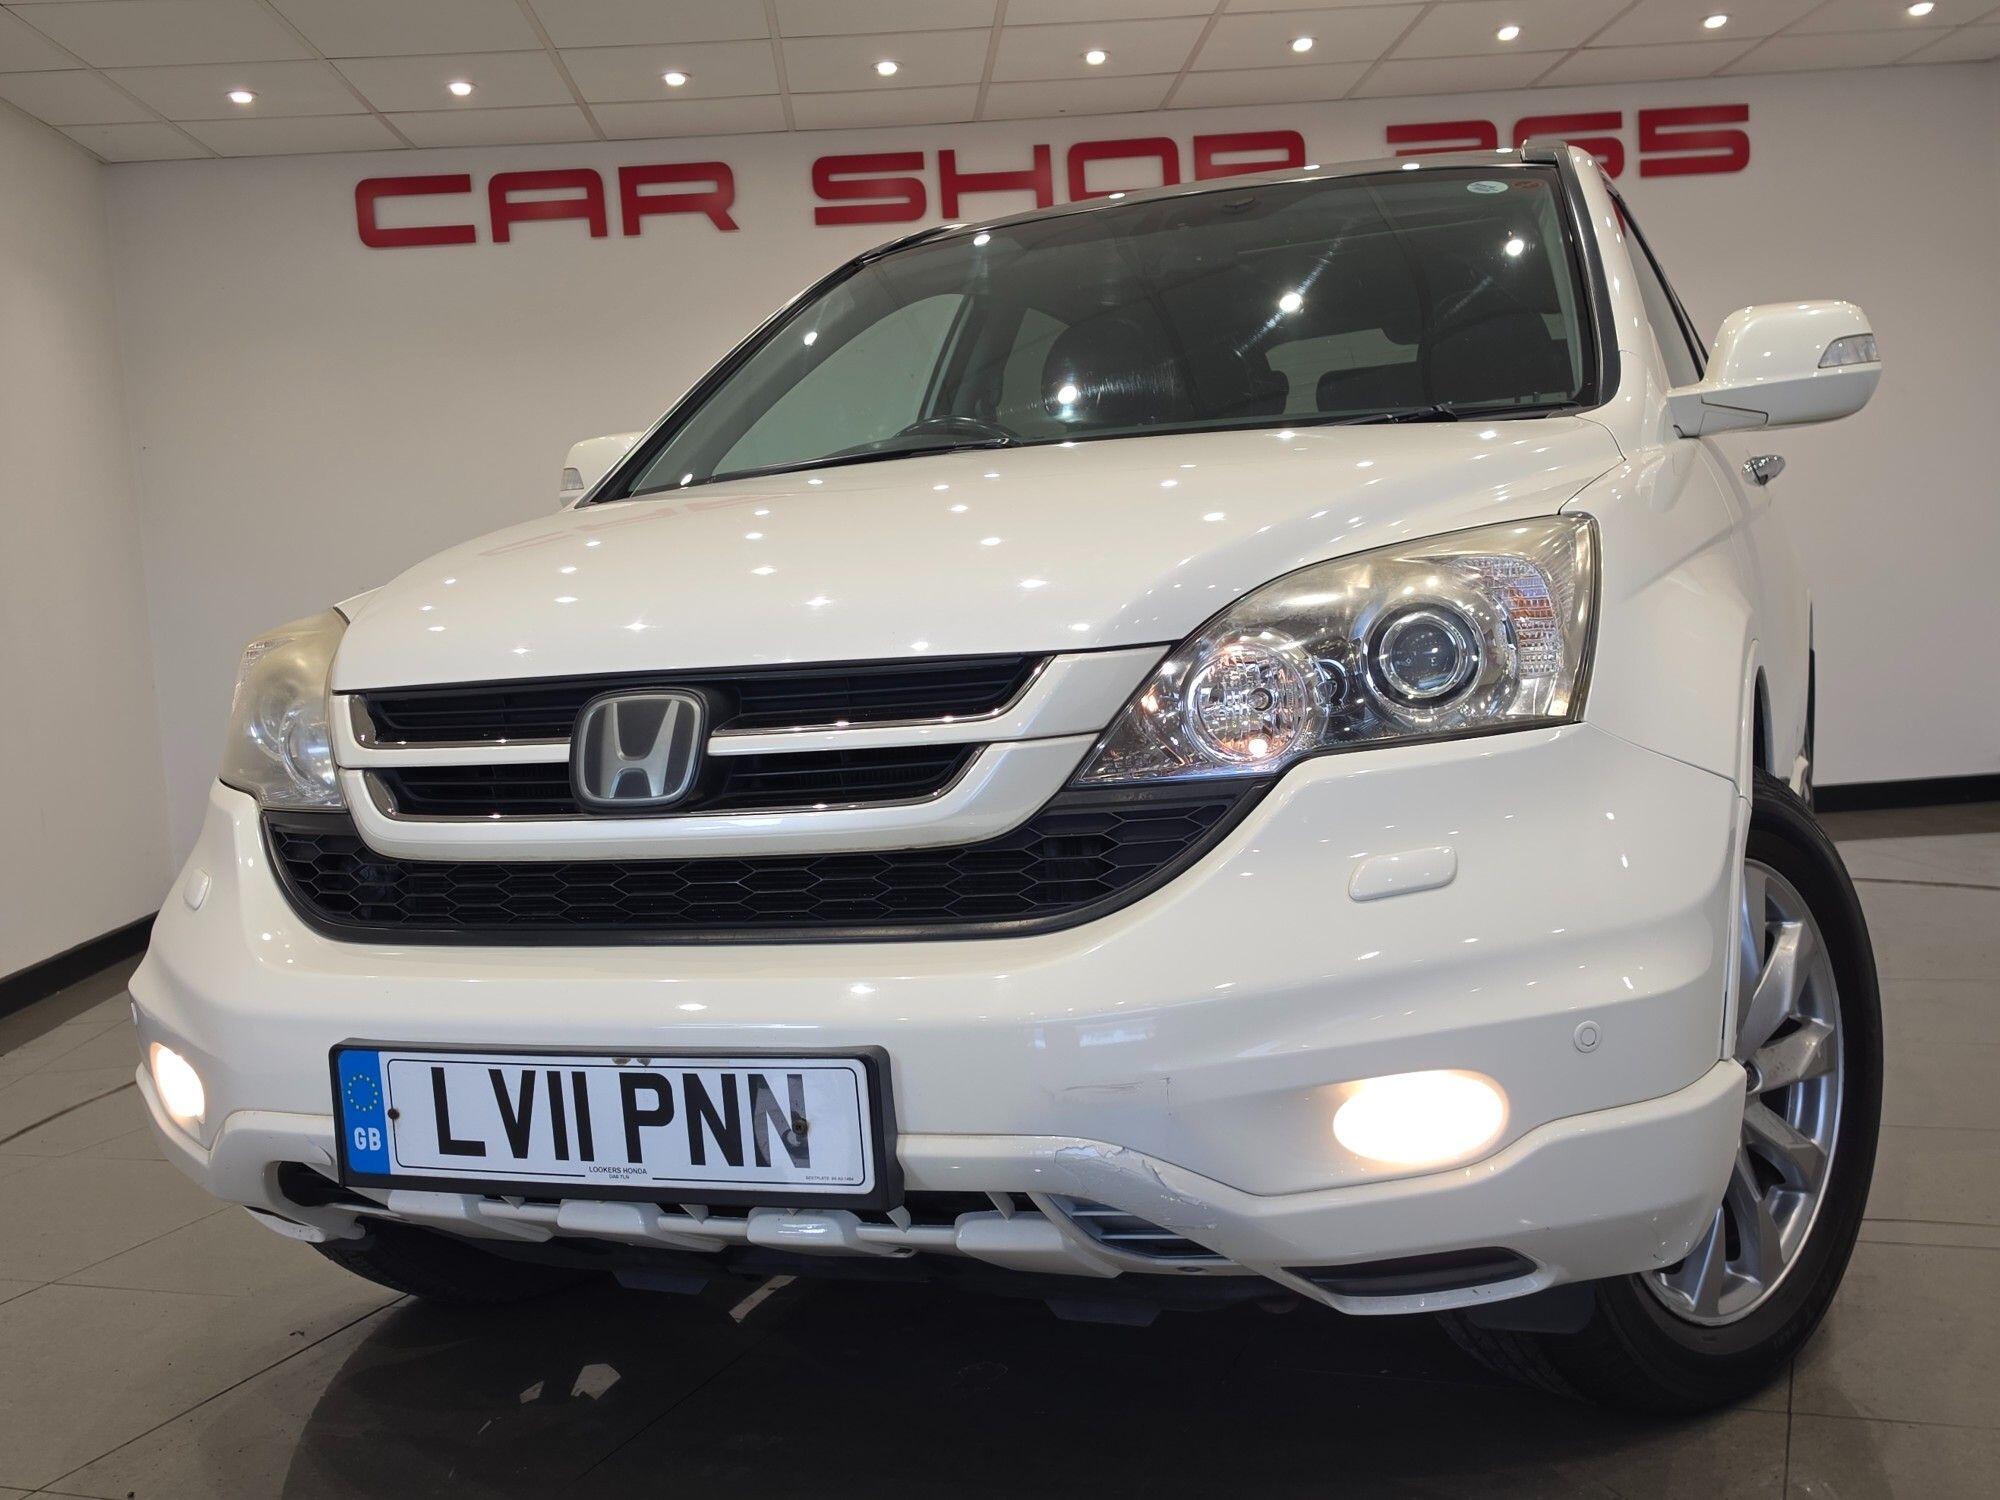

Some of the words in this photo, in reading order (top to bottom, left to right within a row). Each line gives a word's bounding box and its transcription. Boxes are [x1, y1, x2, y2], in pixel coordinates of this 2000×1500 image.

[355, 162, 738, 248] CAR
[812, 130, 1306, 224] SHOP
[354, 1127, 381, 1151] GB
[618, 1072, 811, 1169] PNN
[589, 1166, 622, 1174] LOOKERS
